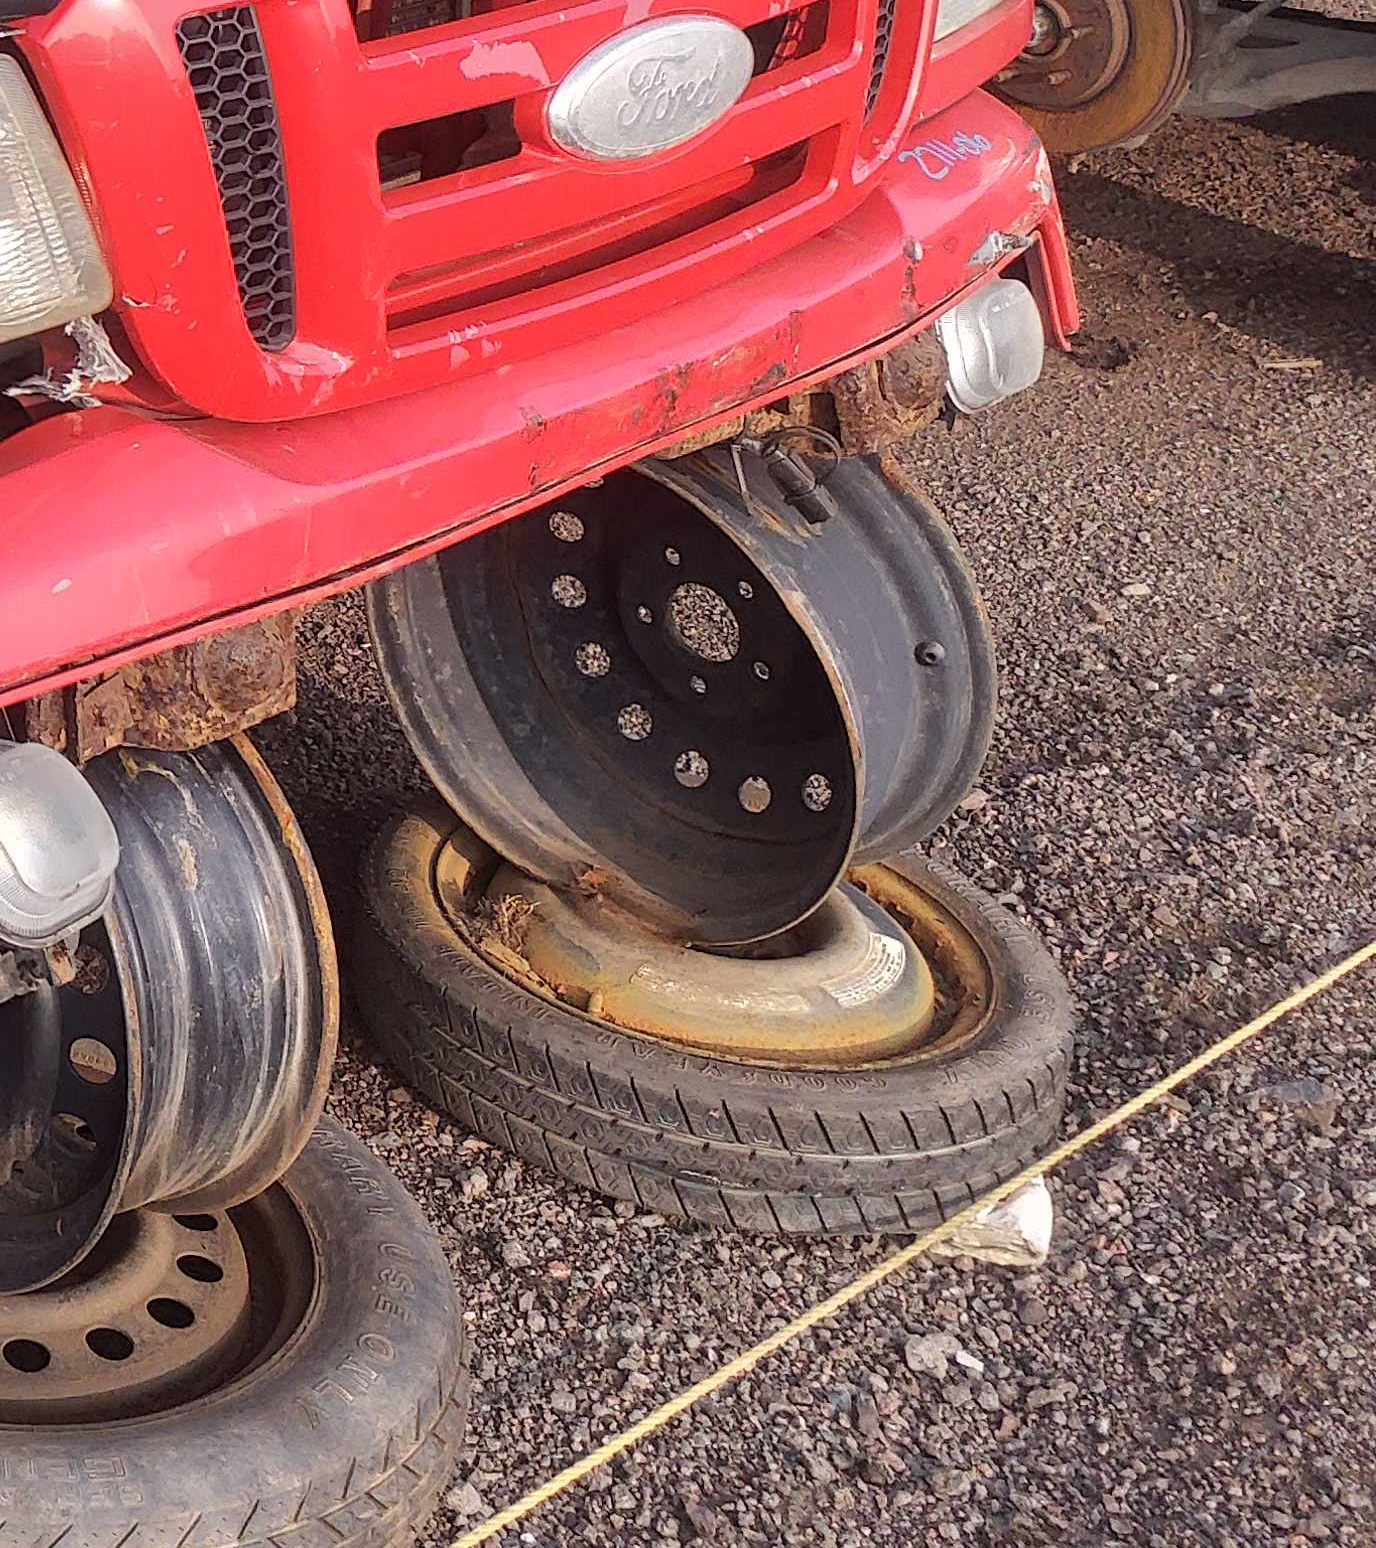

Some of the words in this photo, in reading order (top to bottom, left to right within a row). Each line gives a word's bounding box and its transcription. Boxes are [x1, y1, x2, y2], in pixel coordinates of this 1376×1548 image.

[614, 45, 722, 128] Ford
[374, 1242, 418, 1323] USE
[296, 1332, 397, 1420] ONLY
